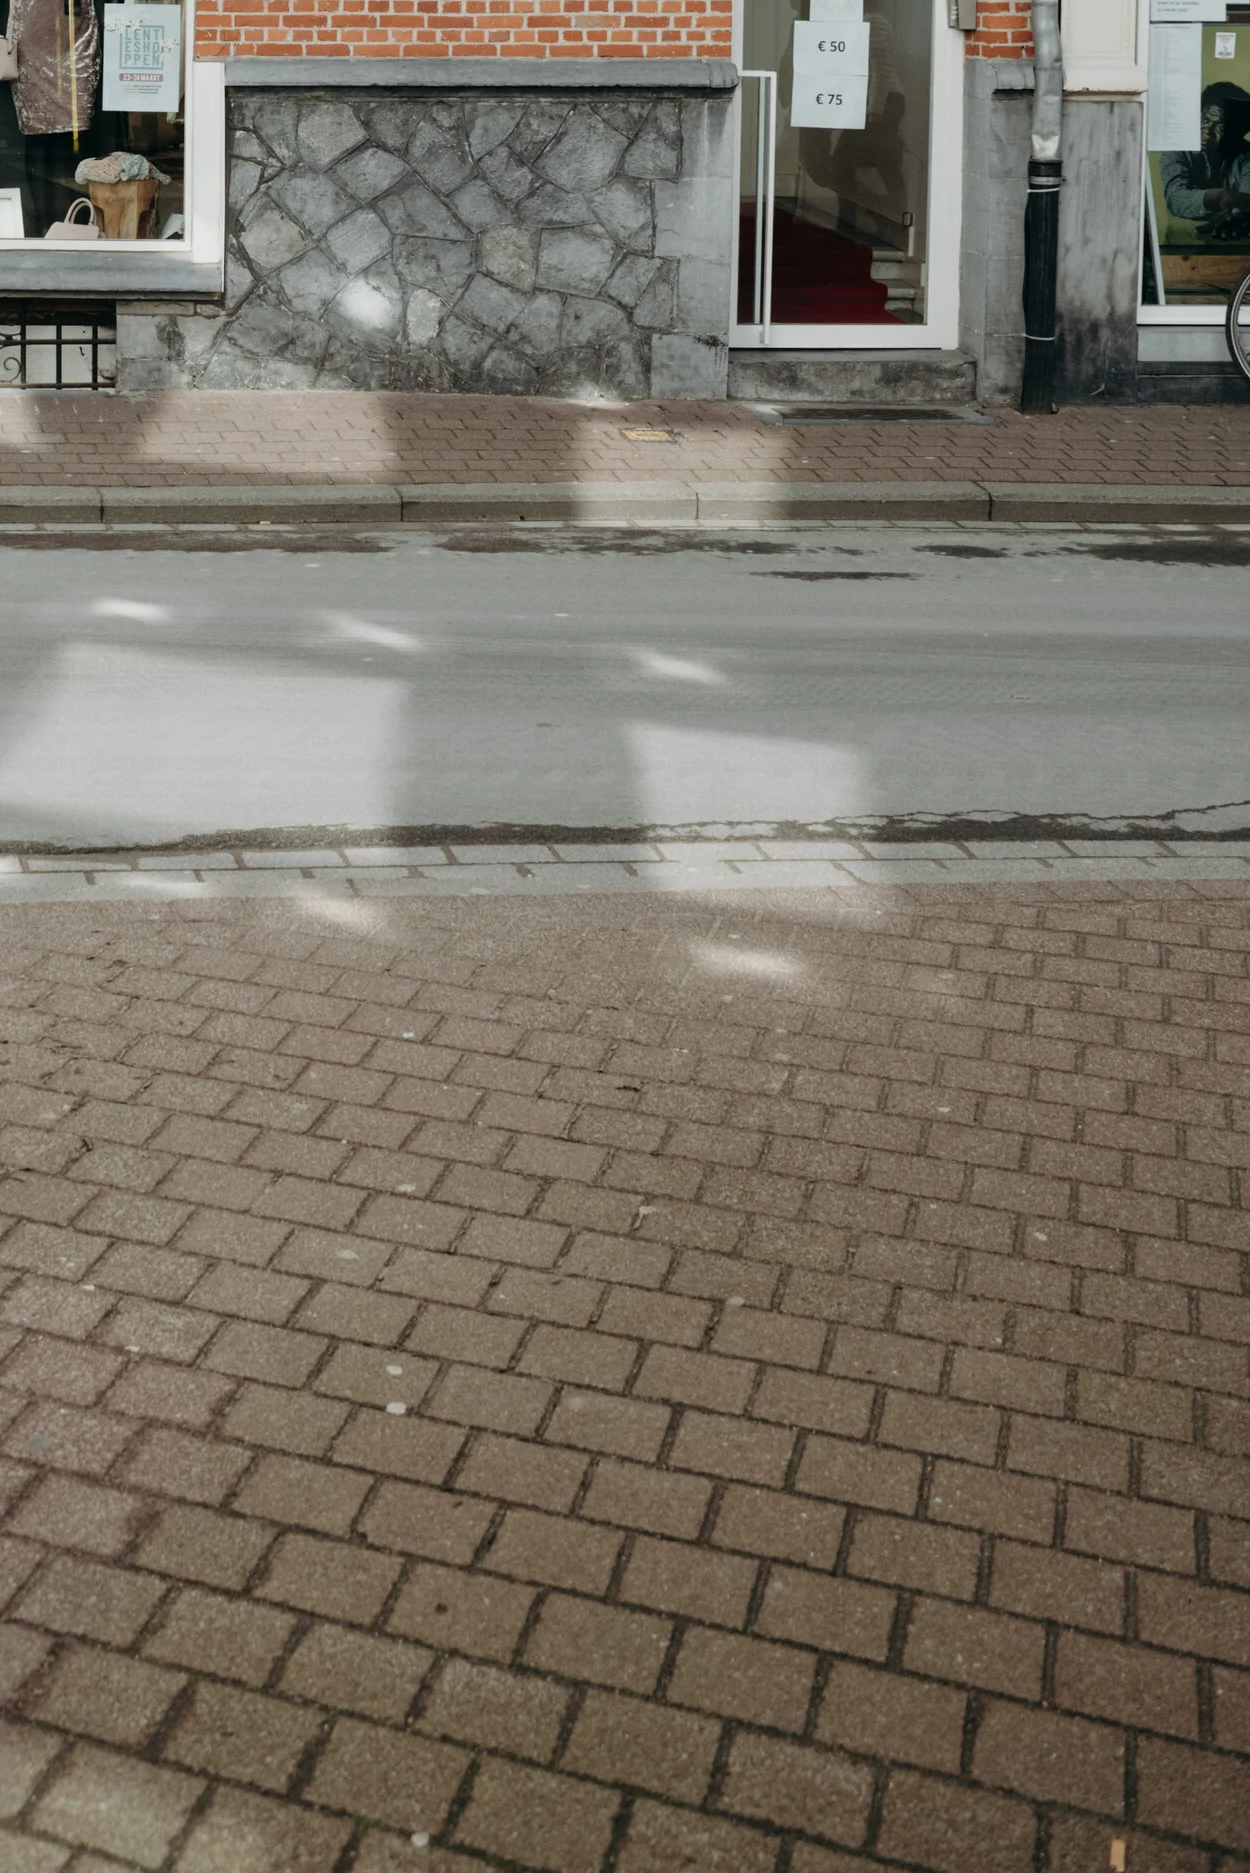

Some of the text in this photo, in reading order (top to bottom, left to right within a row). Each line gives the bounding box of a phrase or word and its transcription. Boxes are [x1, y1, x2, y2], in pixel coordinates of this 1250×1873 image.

[125, 28, 161, 41] LENT
[817, 40, 846, 52] € 50
[124, 54, 160, 66] PPEN
[815, 94, 843, 105] € 75
